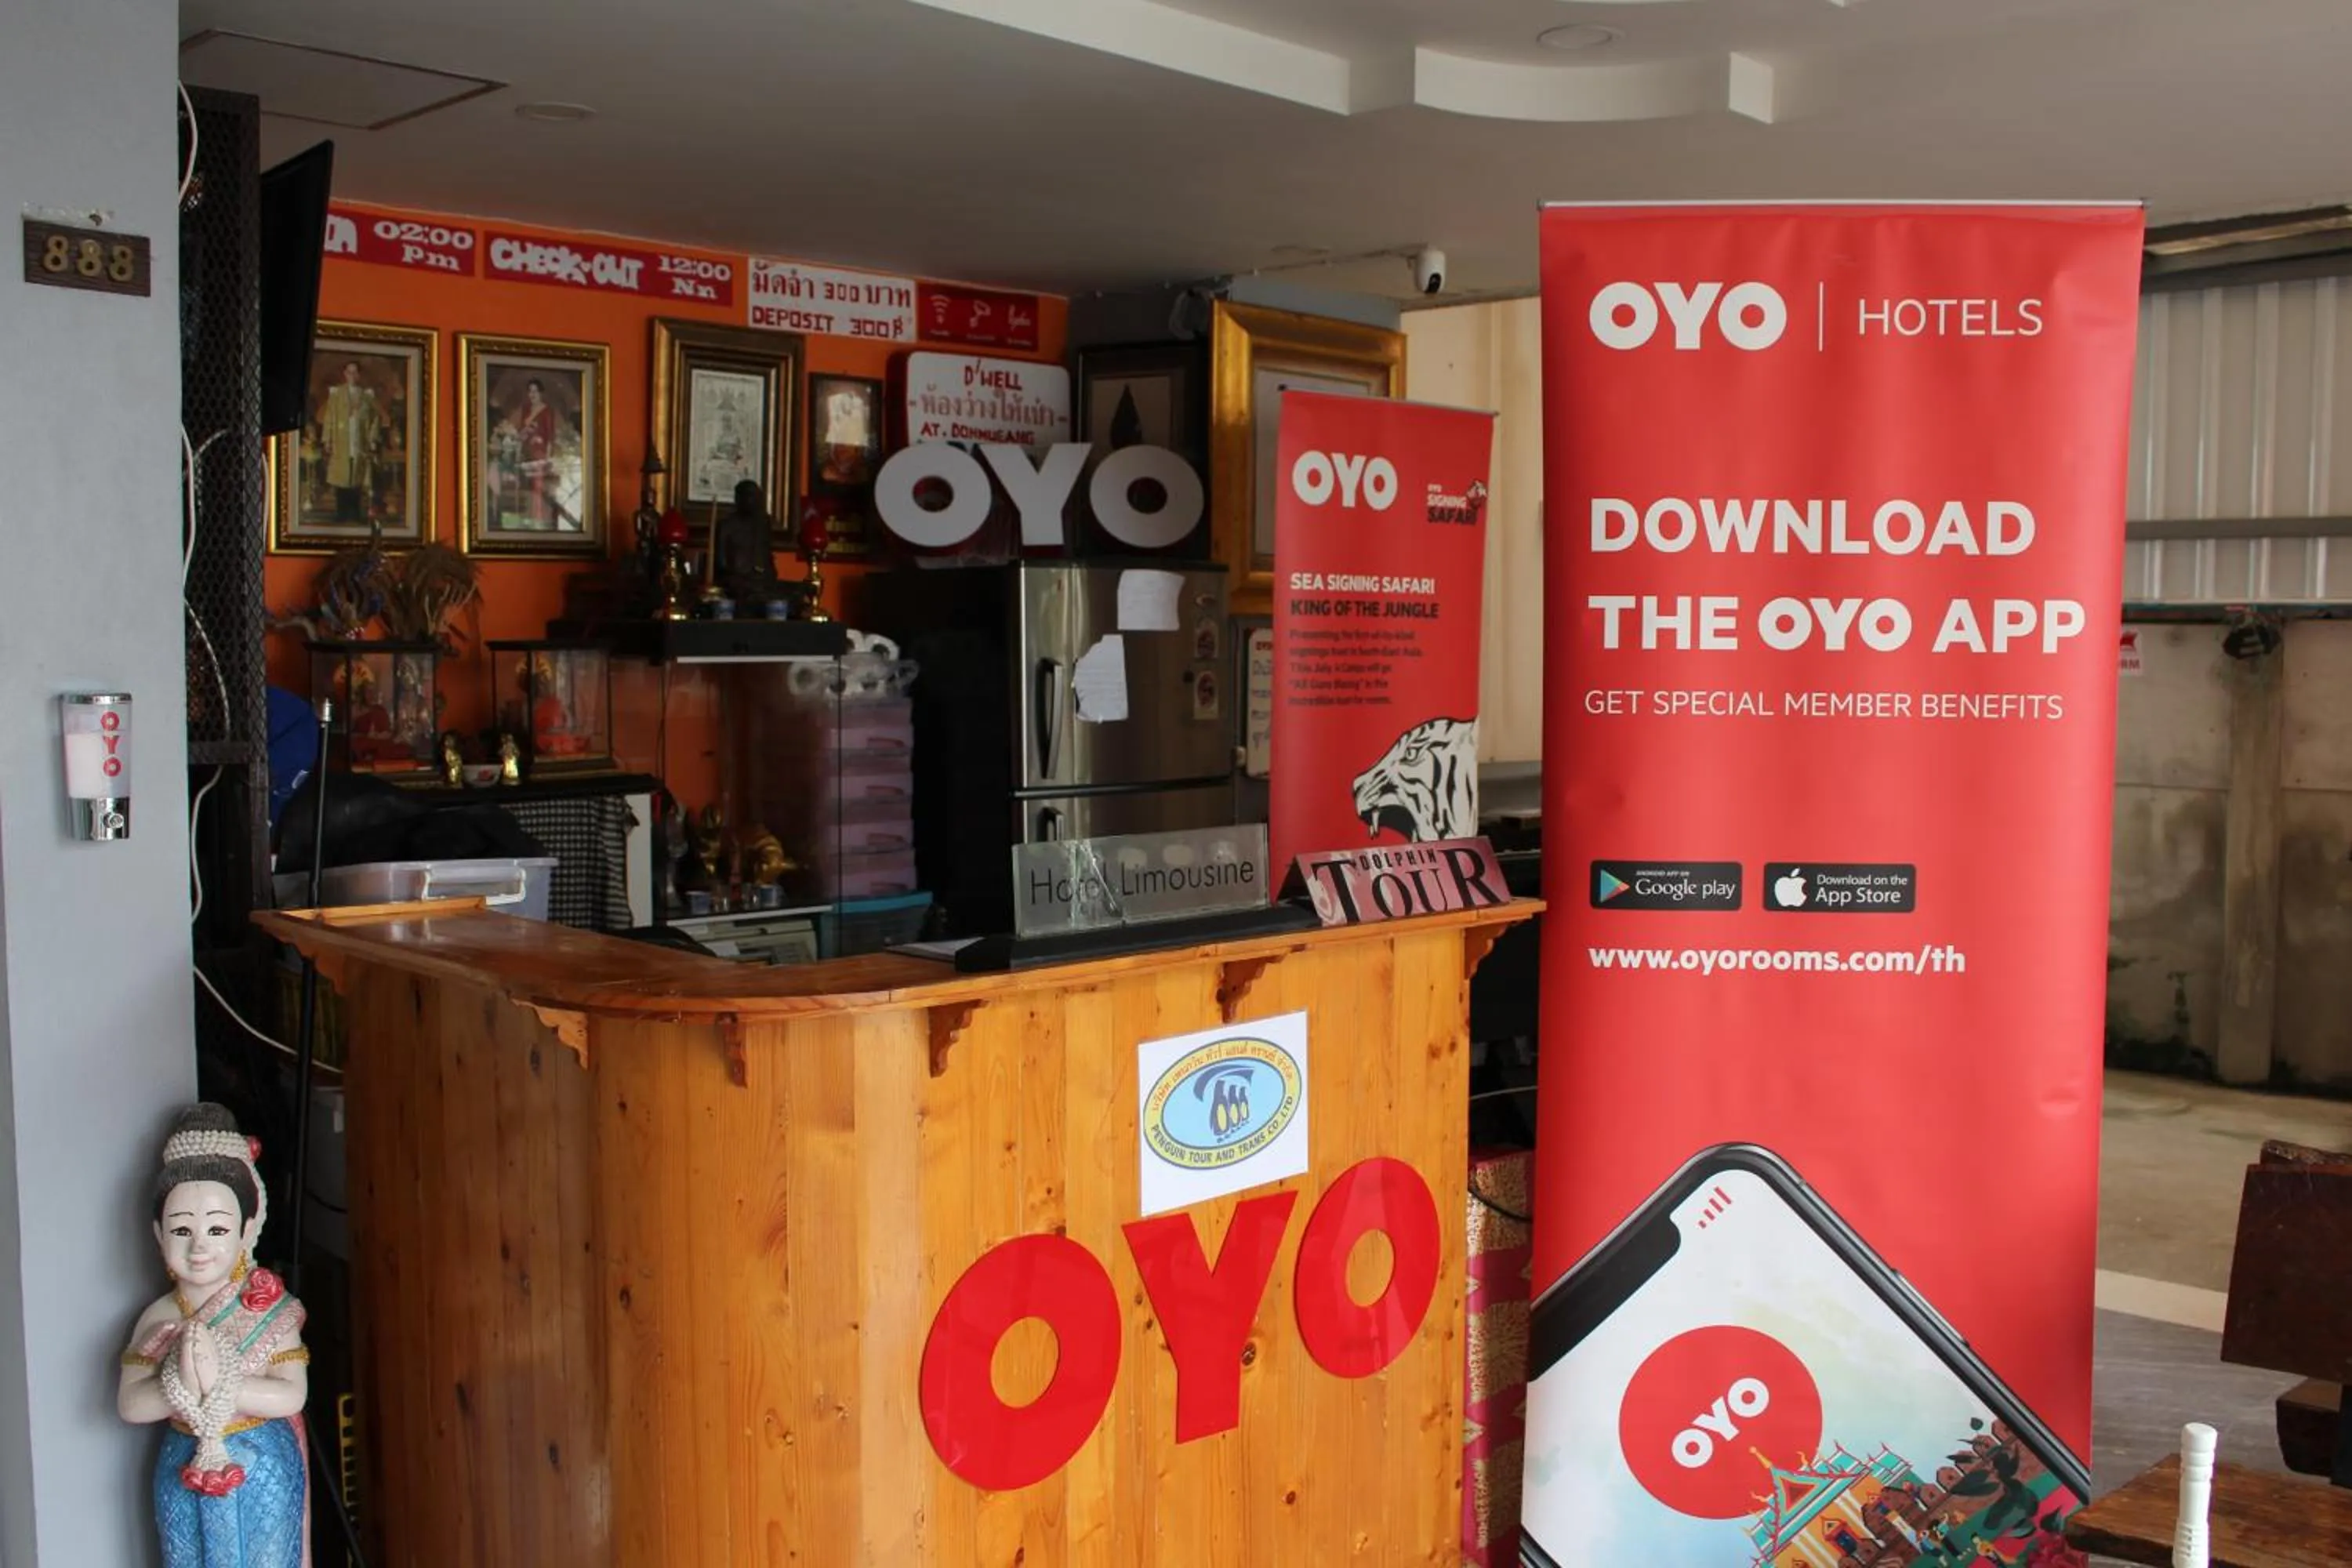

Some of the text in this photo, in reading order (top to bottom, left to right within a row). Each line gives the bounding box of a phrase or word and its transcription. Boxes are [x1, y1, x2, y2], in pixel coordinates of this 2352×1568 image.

[374, 220, 474, 250] 02:00
[43, 234, 134, 282] 888
[657, 255, 731, 281] 12:00
[753, 260, 911, 308] มัดจำ 300 บาท
[752, 305, 835, 333] DEPOSIT
[1588, 281, 2044, 350] OYO HOTELS
[964, 358, 1023, 391] D'WELL
[873, 441, 1205, 548] OYO
[1292, 449, 1398, 511] OYO
[1427, 493, 1468, 509] SIGNING
[1427, 508, 1479, 526] SAFARI
[1590, 497, 2037, 557] DOWNLOAD
[1290, 572, 1436, 594] SEA SIGNING SAFARI
[1290, 599, 1439, 619] KING OF THE JUNGLE
[1588, 594, 2085, 655] THE OYO APP
[1584, 689, 2065, 720] GET SPECIAL MEMBER BENEFITS
[100, 710, 122, 777] OYO
[1359, 848, 1437, 871] DOLPHIN
[1120, 860, 1255, 896] Limousine
[1311, 848, 1511, 926] TOUR
[1635, 878, 1736, 901] Google play
[1817, 873, 1908, 885] Download on the
[1815, 887, 1902, 906] App Store
[1588, 944, 1965, 976] www.oyorooms.com/th
[1150, 1123, 1186, 1160] PENGUIN
[1189, 1151, 1213, 1163] TOUR
[1216, 1149, 1235, 1163] AND
[1238, 1131, 1267, 1152] TRANS
[918, 1156, 1441, 1492] OYO
[1671, 1376, 1770, 1469] OYO
